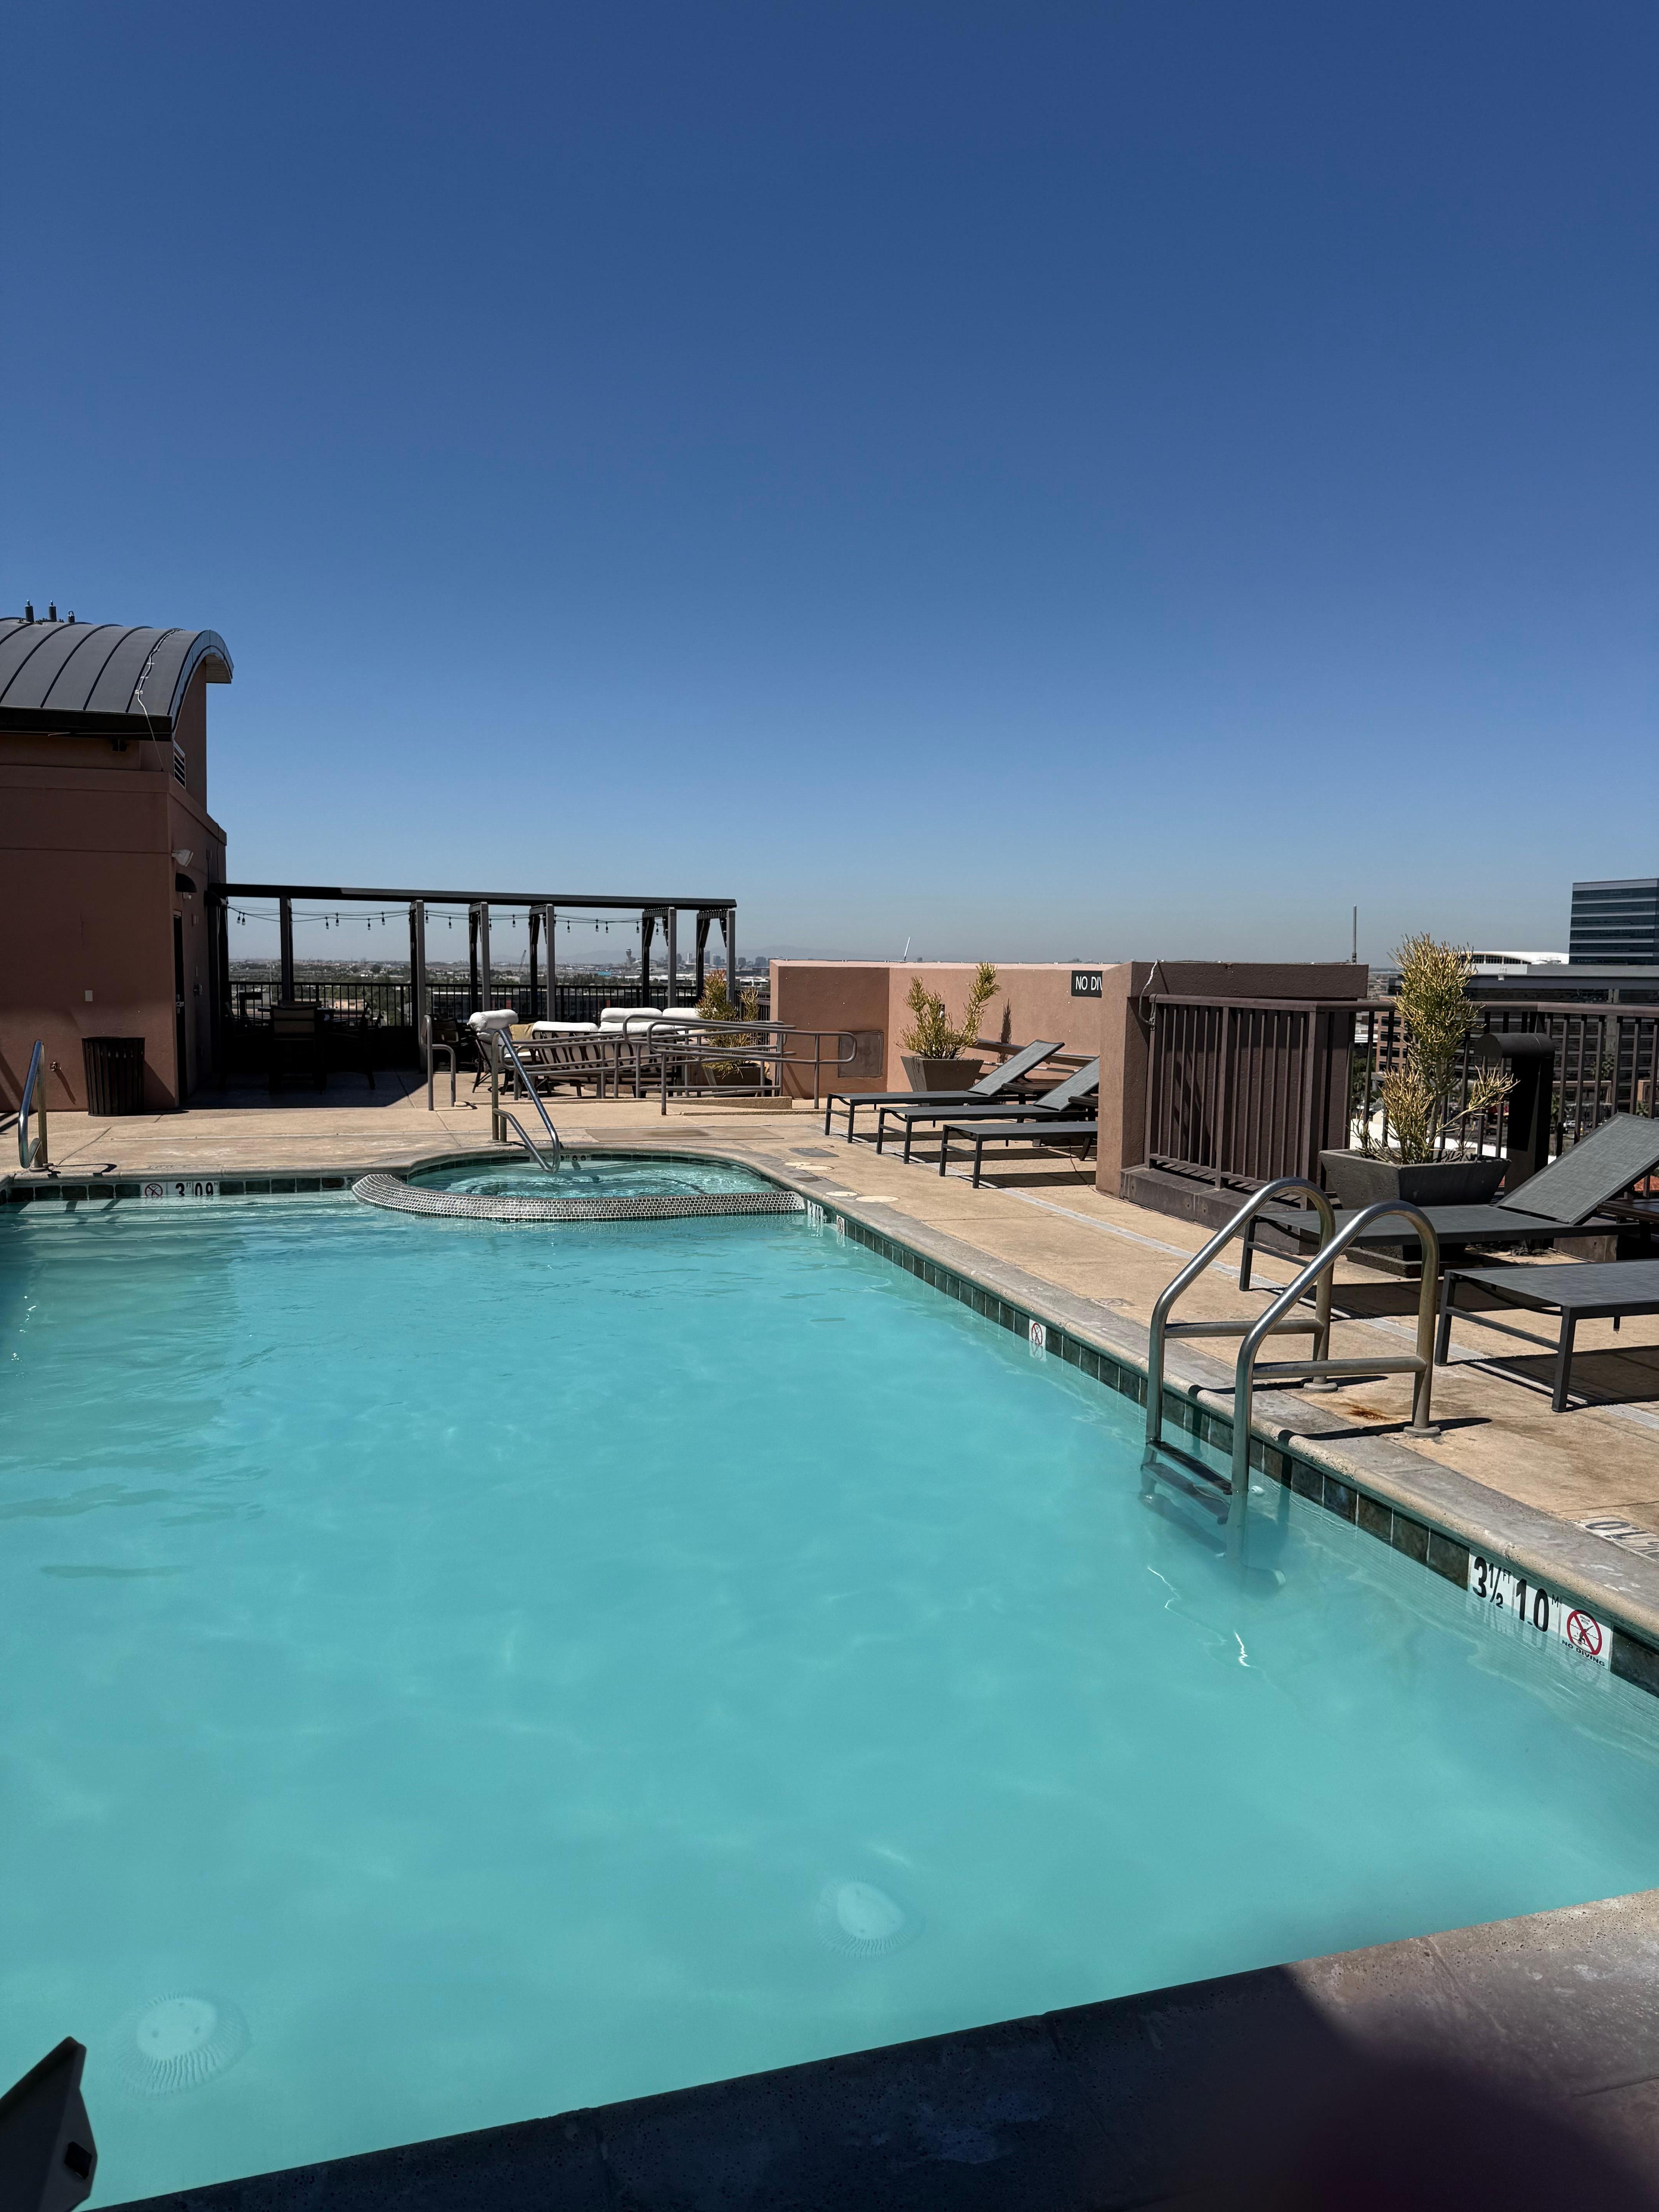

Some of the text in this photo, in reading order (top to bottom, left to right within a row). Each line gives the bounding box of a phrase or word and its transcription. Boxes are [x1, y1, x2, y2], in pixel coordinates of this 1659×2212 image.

[1076, 976, 1087, 990] NO
[1503, 1569, 1511, 1584] FT
[1552, 1594, 1559, 1608] M
[1562, 1640, 1605, 1666] NO DIVING
